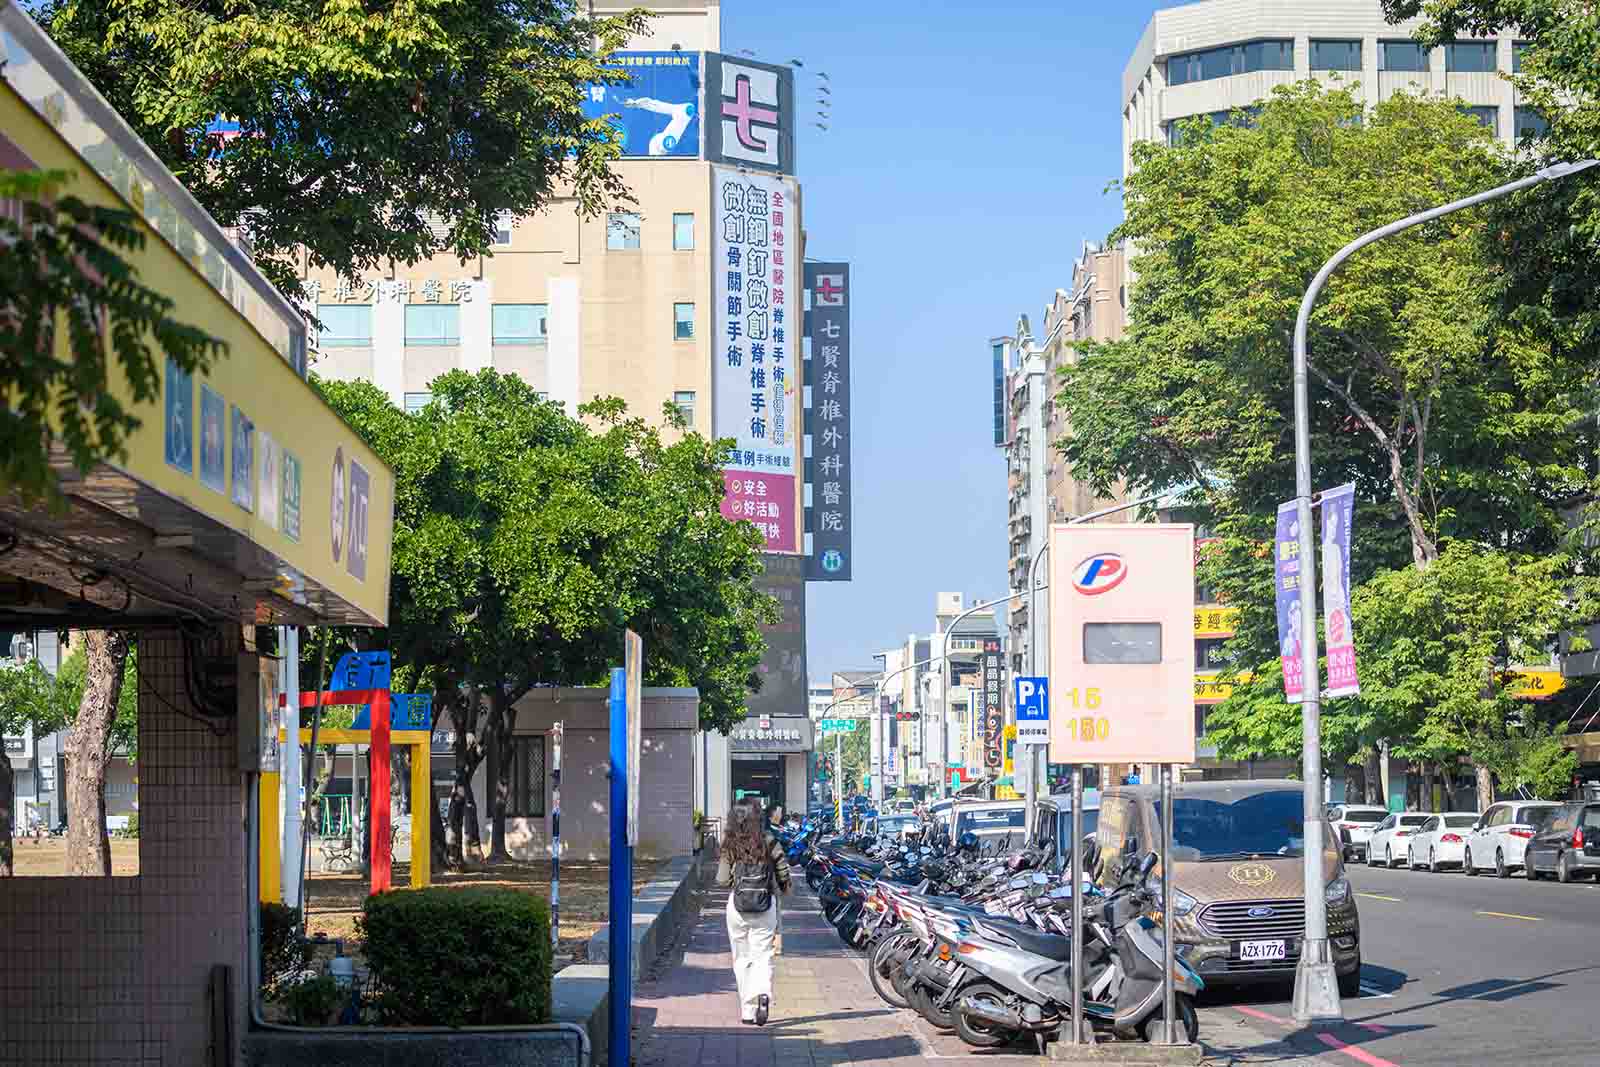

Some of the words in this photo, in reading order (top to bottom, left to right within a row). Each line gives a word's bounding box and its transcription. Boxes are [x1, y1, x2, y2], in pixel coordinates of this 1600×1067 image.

[723, 182, 745, 366] 微創骨關節手術
[747, 185, 768, 438] 無鋼釘微創脊椎手術
[816, 319, 846, 532] 七賢脊椎外科醫院
[744, 480, 767, 496] 安全
[744, 500, 779, 518] 好活動
[1019, 681, 1035, 705] P
[1066, 687, 1103, 709] 15
